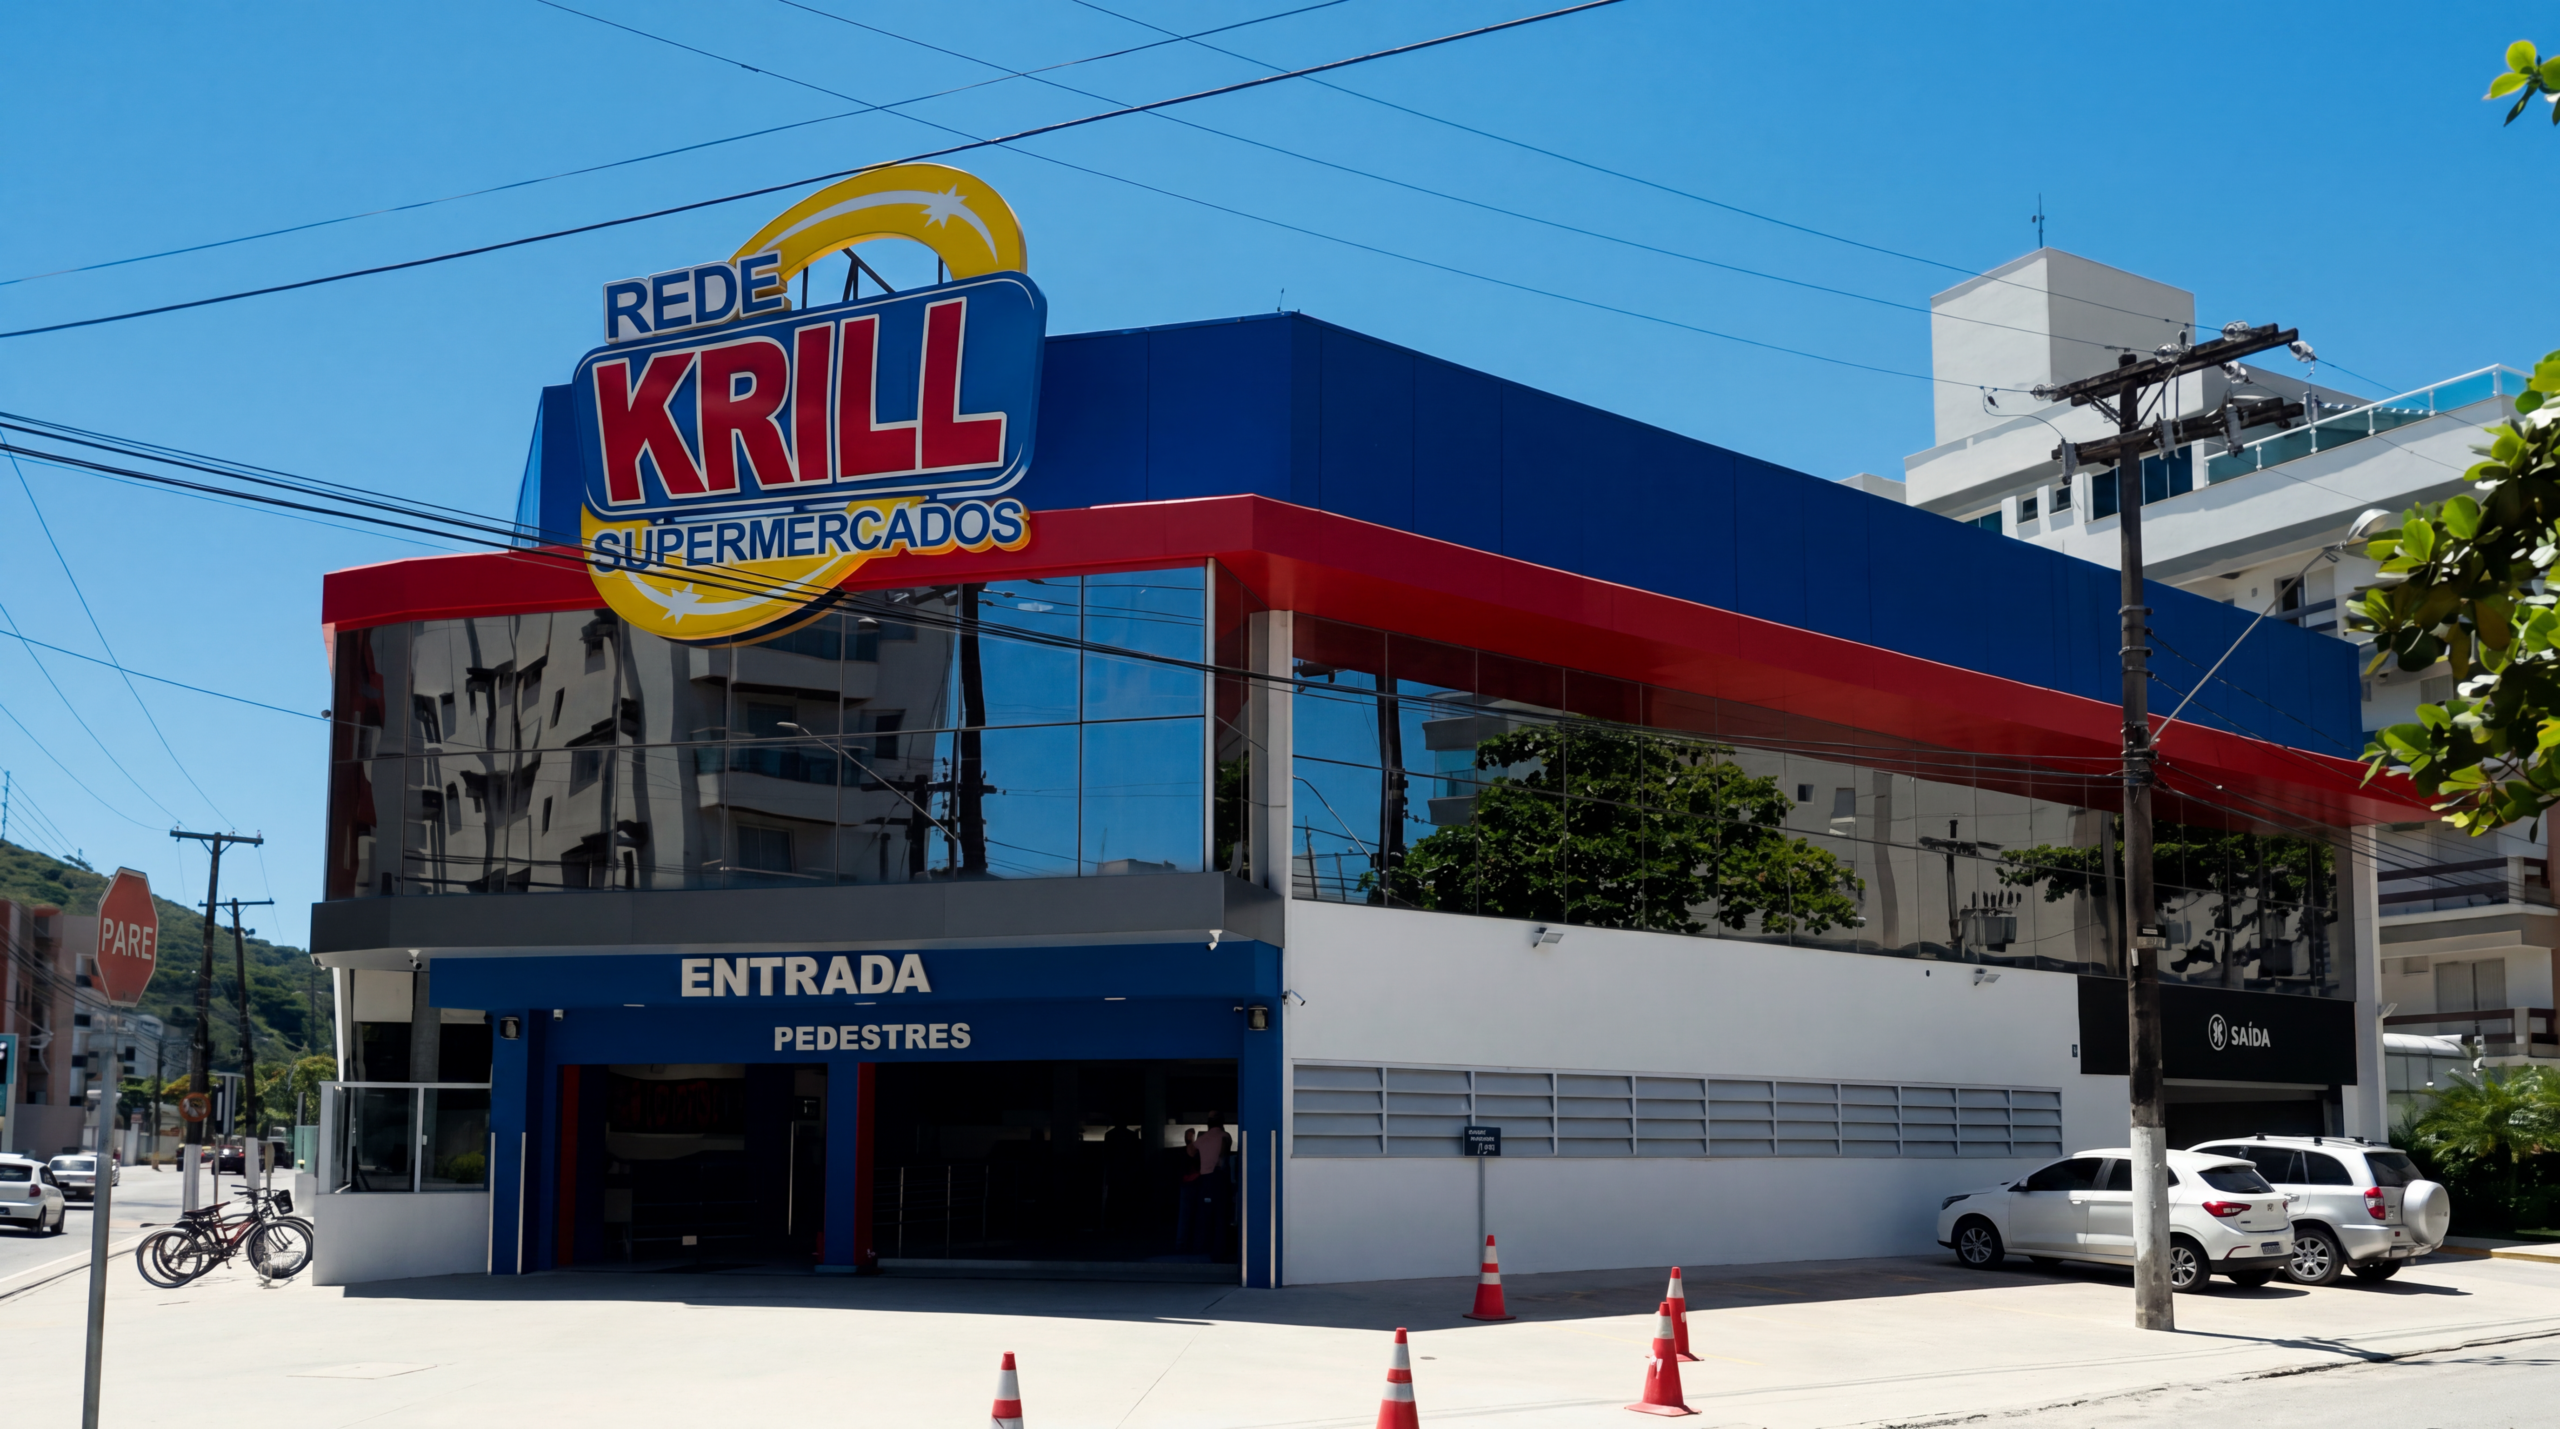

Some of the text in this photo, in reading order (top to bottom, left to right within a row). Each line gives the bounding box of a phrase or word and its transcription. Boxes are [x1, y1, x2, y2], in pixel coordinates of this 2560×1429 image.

[604, 251, 783, 342] REDE
[593, 297, 1007, 505] KRILL
[594, 500, 1024, 573] SUPERMERCADOS
[101, 917, 154, 961] PARE
[681, 953, 932, 998] ENTRADA
[774, 1022, 972, 1052] PEDESTRES
[2231, 1021, 2271, 1048] SAÍDA
